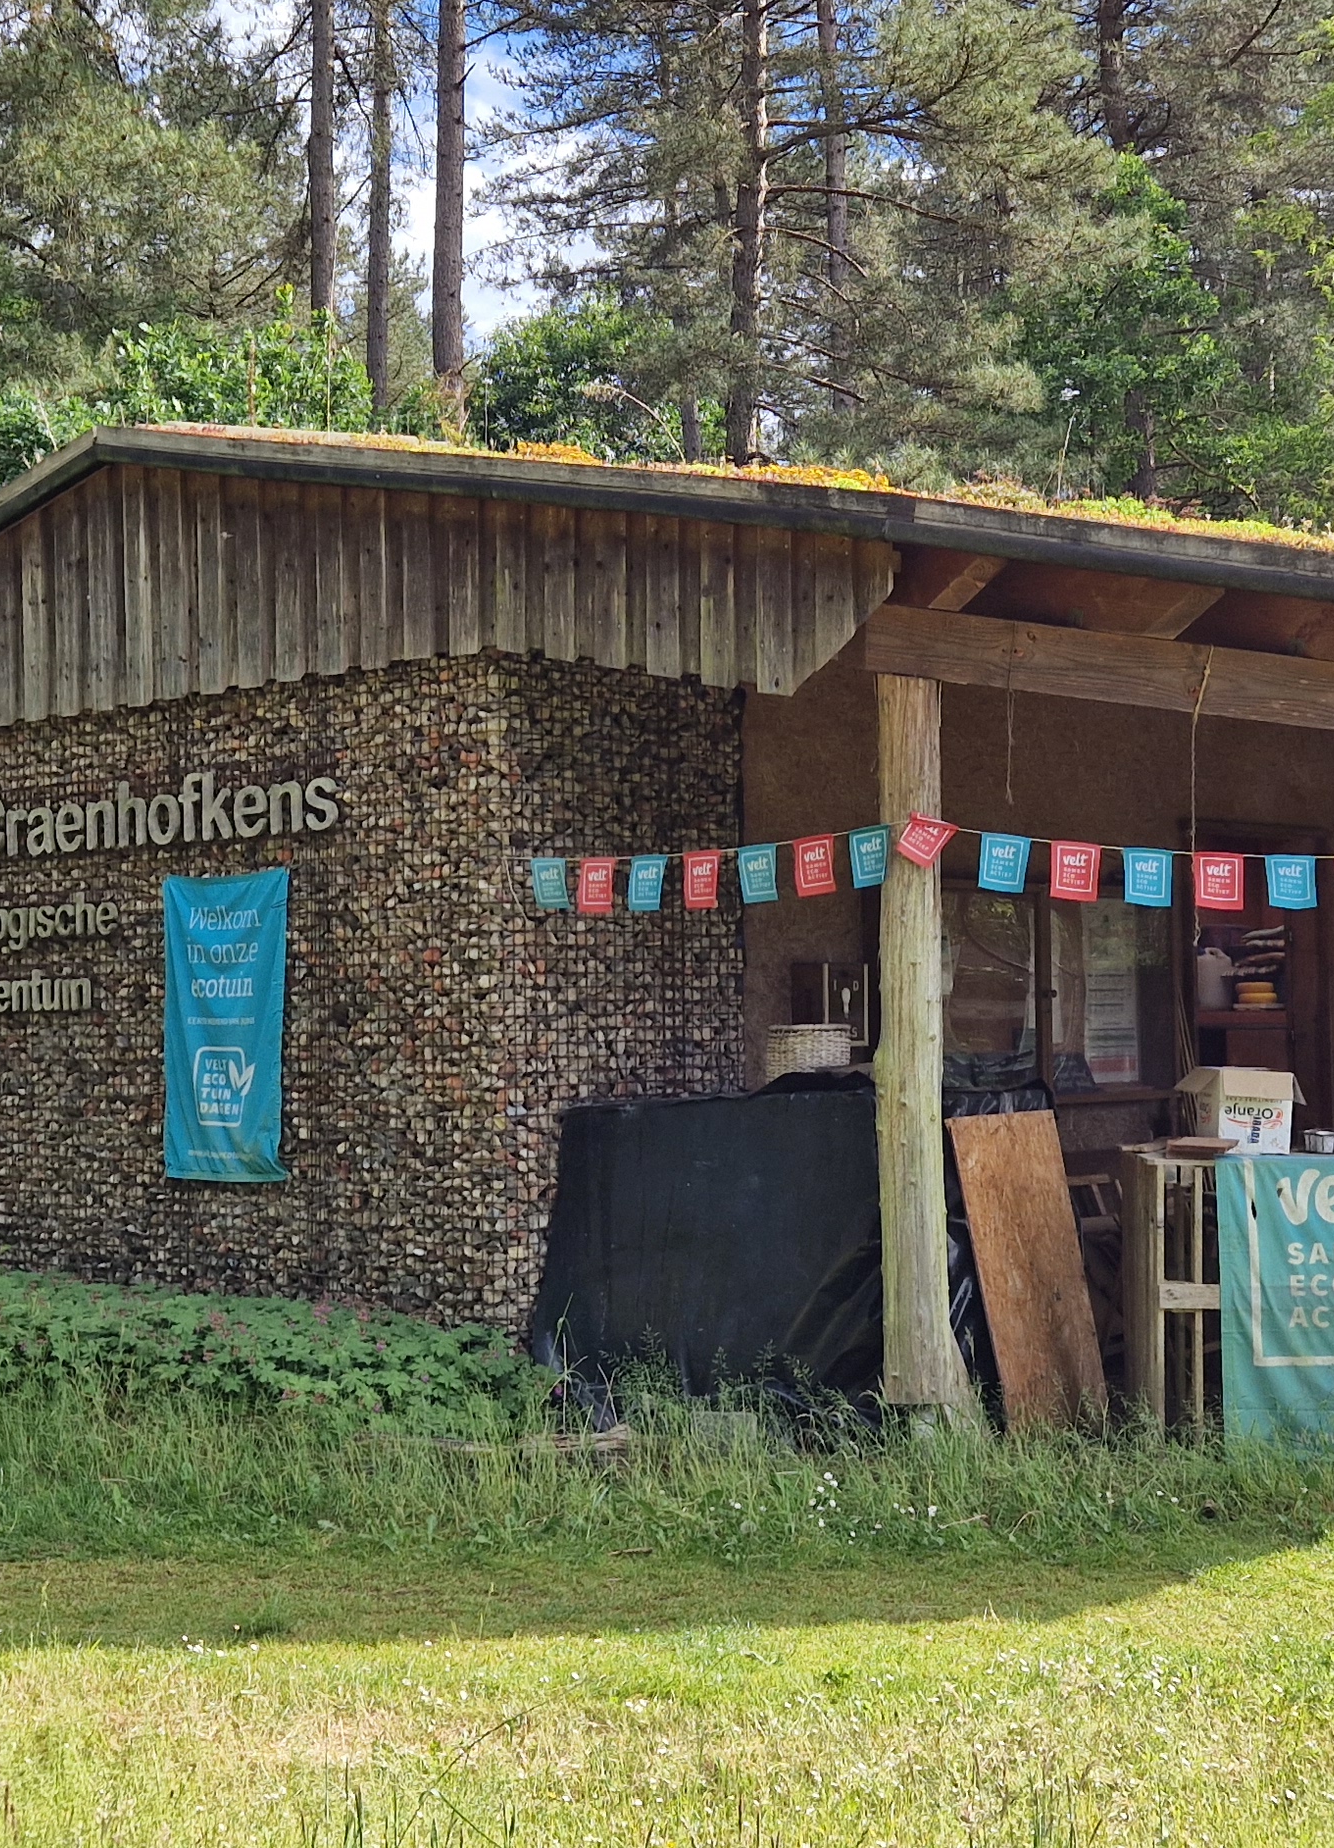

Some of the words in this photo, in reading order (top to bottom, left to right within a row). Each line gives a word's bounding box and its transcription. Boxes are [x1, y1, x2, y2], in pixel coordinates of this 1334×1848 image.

[859, 837, 882, 853] velt
[992, 845, 1016, 859] velt
[804, 846, 825, 862] velt
[1063, 853, 1088, 866] velt
[692, 862, 713, 877] velt
[747, 856, 769, 871] velt
[1135, 859, 1159, 873] velt
[1206, 863, 1232, 876] velt
[1278, 864, 1303, 877] velt
[539, 867, 559, 880] velt
[588, 868, 608, 881] velt
[637, 866, 658, 880] velt
[189, 905, 262, 931] Welkom
[187, 937, 206, 964] in
[209, 942, 258, 964] onze
[191, 971, 254, 998] ecotuin
[205, 1058, 227, 1071] VELT
[203, 1073, 227, 1086] ECO
[201, 1087, 231, 1100] TUIN
[1224, 1102, 1273, 1119] Oranje
